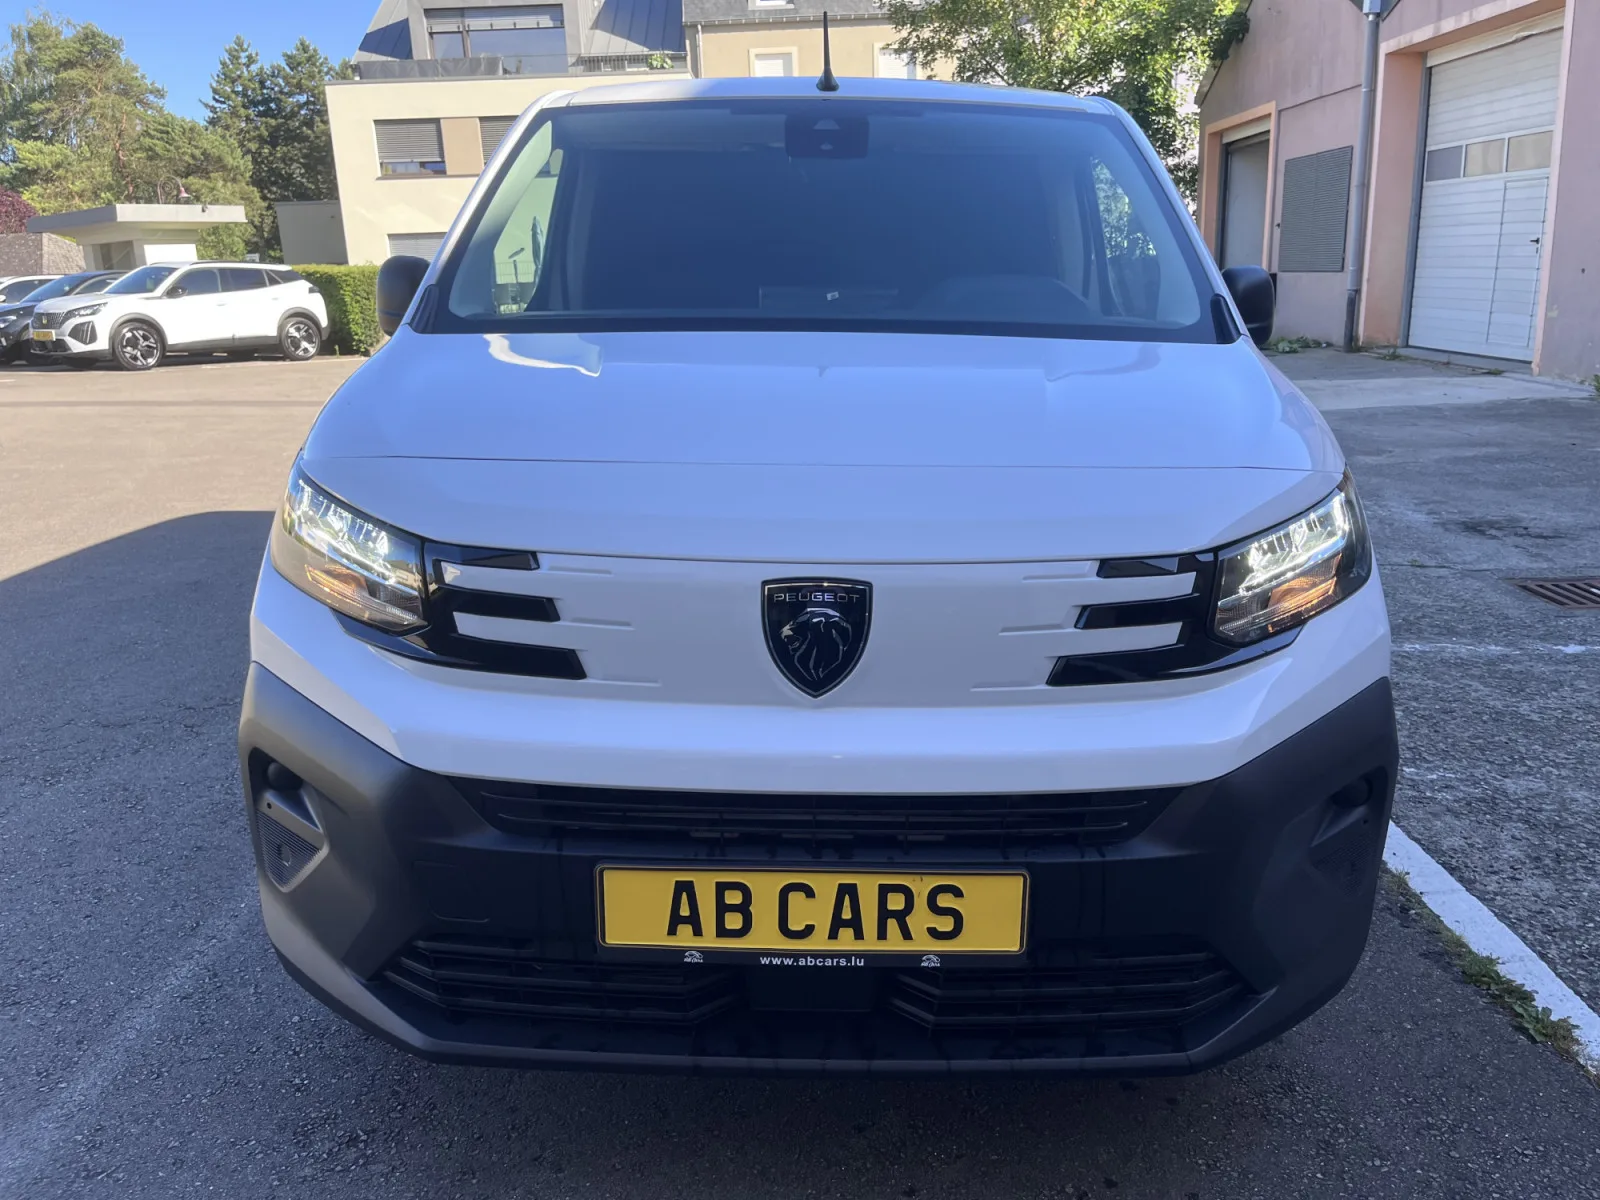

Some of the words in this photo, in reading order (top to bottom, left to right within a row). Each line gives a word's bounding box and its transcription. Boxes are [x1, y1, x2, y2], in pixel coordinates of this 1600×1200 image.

[774, 592, 860, 603] PEUGEOT
[666, 880, 754, 938] AB
[777, 882, 965, 941] CARS
[760, 955, 865, 966] www.abcars.lu
